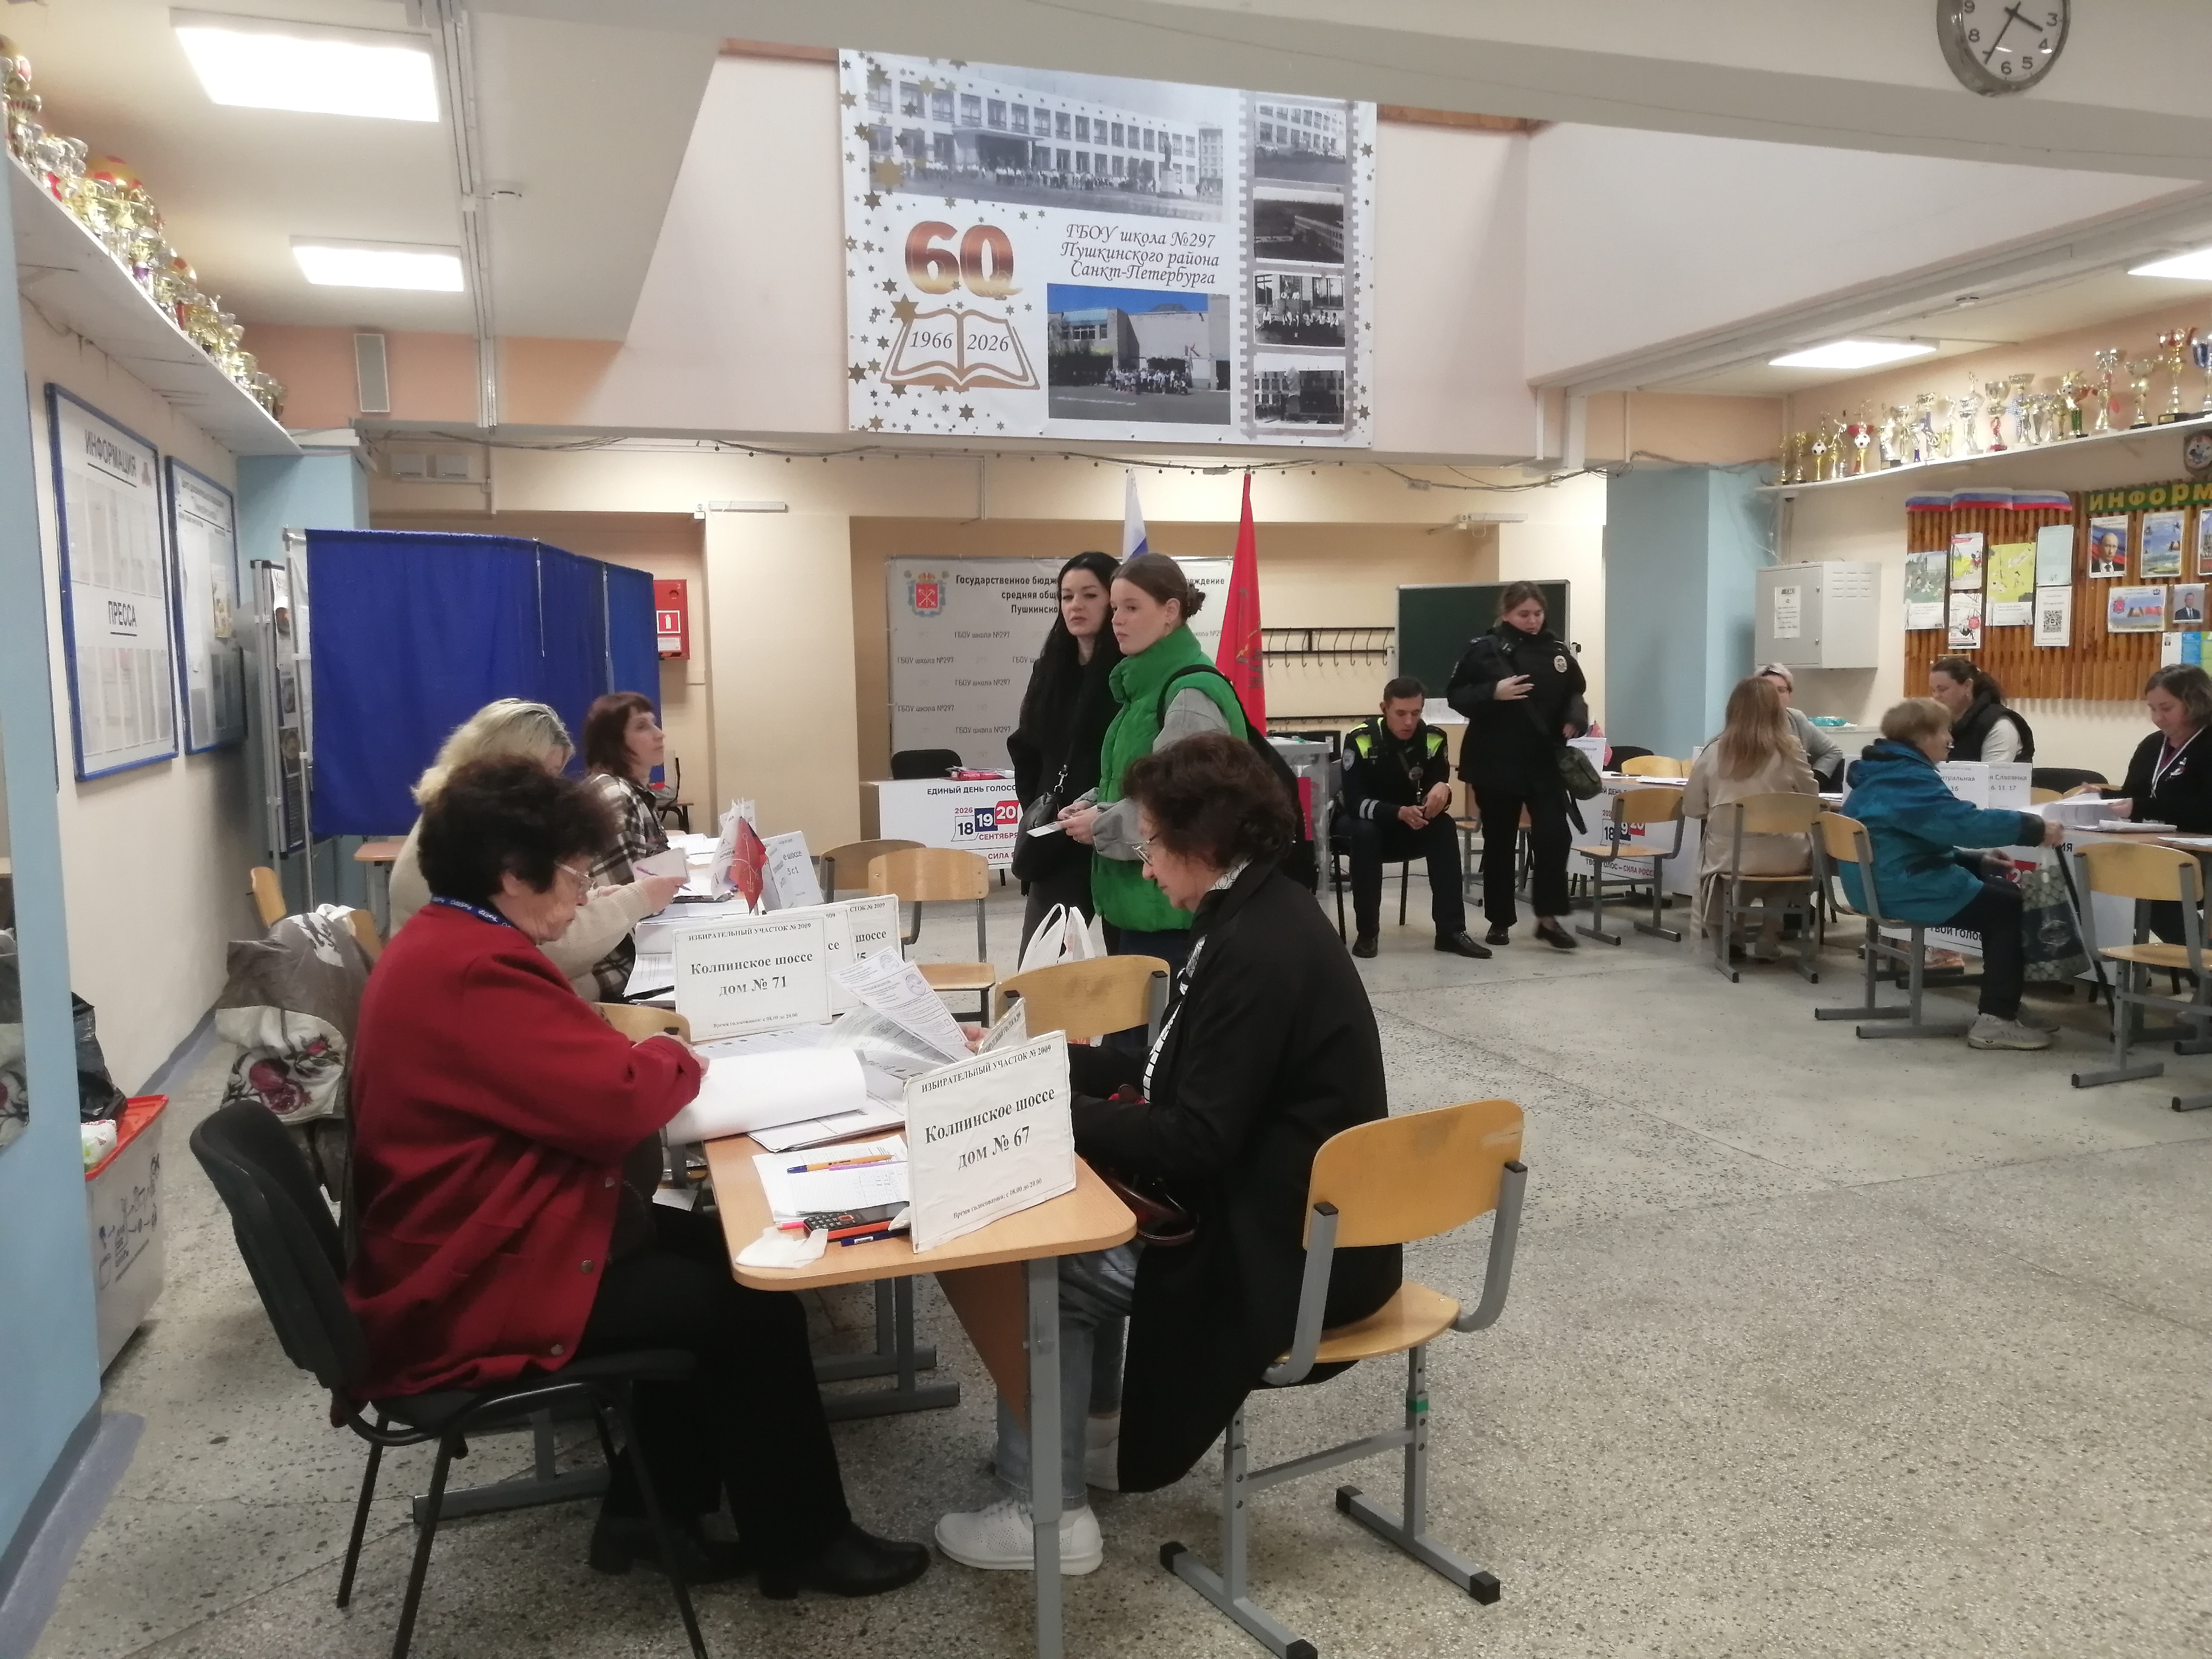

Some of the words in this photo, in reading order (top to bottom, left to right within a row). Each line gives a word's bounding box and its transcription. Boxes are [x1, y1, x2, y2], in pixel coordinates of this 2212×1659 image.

[1964, 1, 1975, 14] 9
[2046, 12, 2058, 27] 3
[1968, 28, 1980, 43] 8
[2001, 61, 2012, 75] 6
[2022, 56, 2033, 70] 5
[1066, 224, 1118, 243] ГБОУ
[1120, 231, 1166, 247] школа
[1170, 231, 1216, 249] №297
[905, 221, 1015, 298] 60
[1060, 241, 1164, 265] Пушкинского
[1167, 251, 1220, 268] района
[1071, 260, 1216, 288] Санкт-Петербурга
[910, 331, 954, 350] 1966
[967, 333, 1010, 352] 2026
[2089, 482, 2212, 512] ИНФОРМ
[955, 575, 1030, 586] Государственное
[1001, 591, 1037, 600] средняя
[108, 600, 137, 627] ПРЕССА
[1011, 604, 1058, 615] Пушкинско
[927, 785, 962, 795] ЕДИНЫЙ
[986, 784, 1016, 793] ГОЛОСО
[996, 805, 1016, 820] 20
[976, 813, 993, 828] 19
[957, 822, 974, 836] 18
[979, 832, 1018, 841] СЕНТЯБРЯ
[1638, 867, 1654, 876] РОСС
[688, 928, 753, 941] ИЗБИРАТЕЛЬНЫЙ
[754, 925, 788, 935] УЧАСТОК
[855, 930, 887, 943] шоссе
[690, 958, 772, 976] Колпинское
[775, 953, 813, 966] шоссе
[719, 983, 747, 997] дом
[751, 978, 768, 992] №
[772, 975, 787, 989] 71
[921, 1063, 991, 1093] ИЗБИРАТЕЛЬНЫЙ
[993, 1052, 1029, 1070] УЧАСТОК
[1029, 1050, 1037, 1059] №
[1038, 1044, 1051, 1055] 2009
[925, 1103, 1012, 1144] Колпинское
[1016, 1088, 1055, 1112] шоссе
[958, 1146, 988, 1171] дом
[992, 1134, 1010, 1155] №
[1013, 1124, 1030, 1147] 67
[953, 1208, 970, 1220] Время
